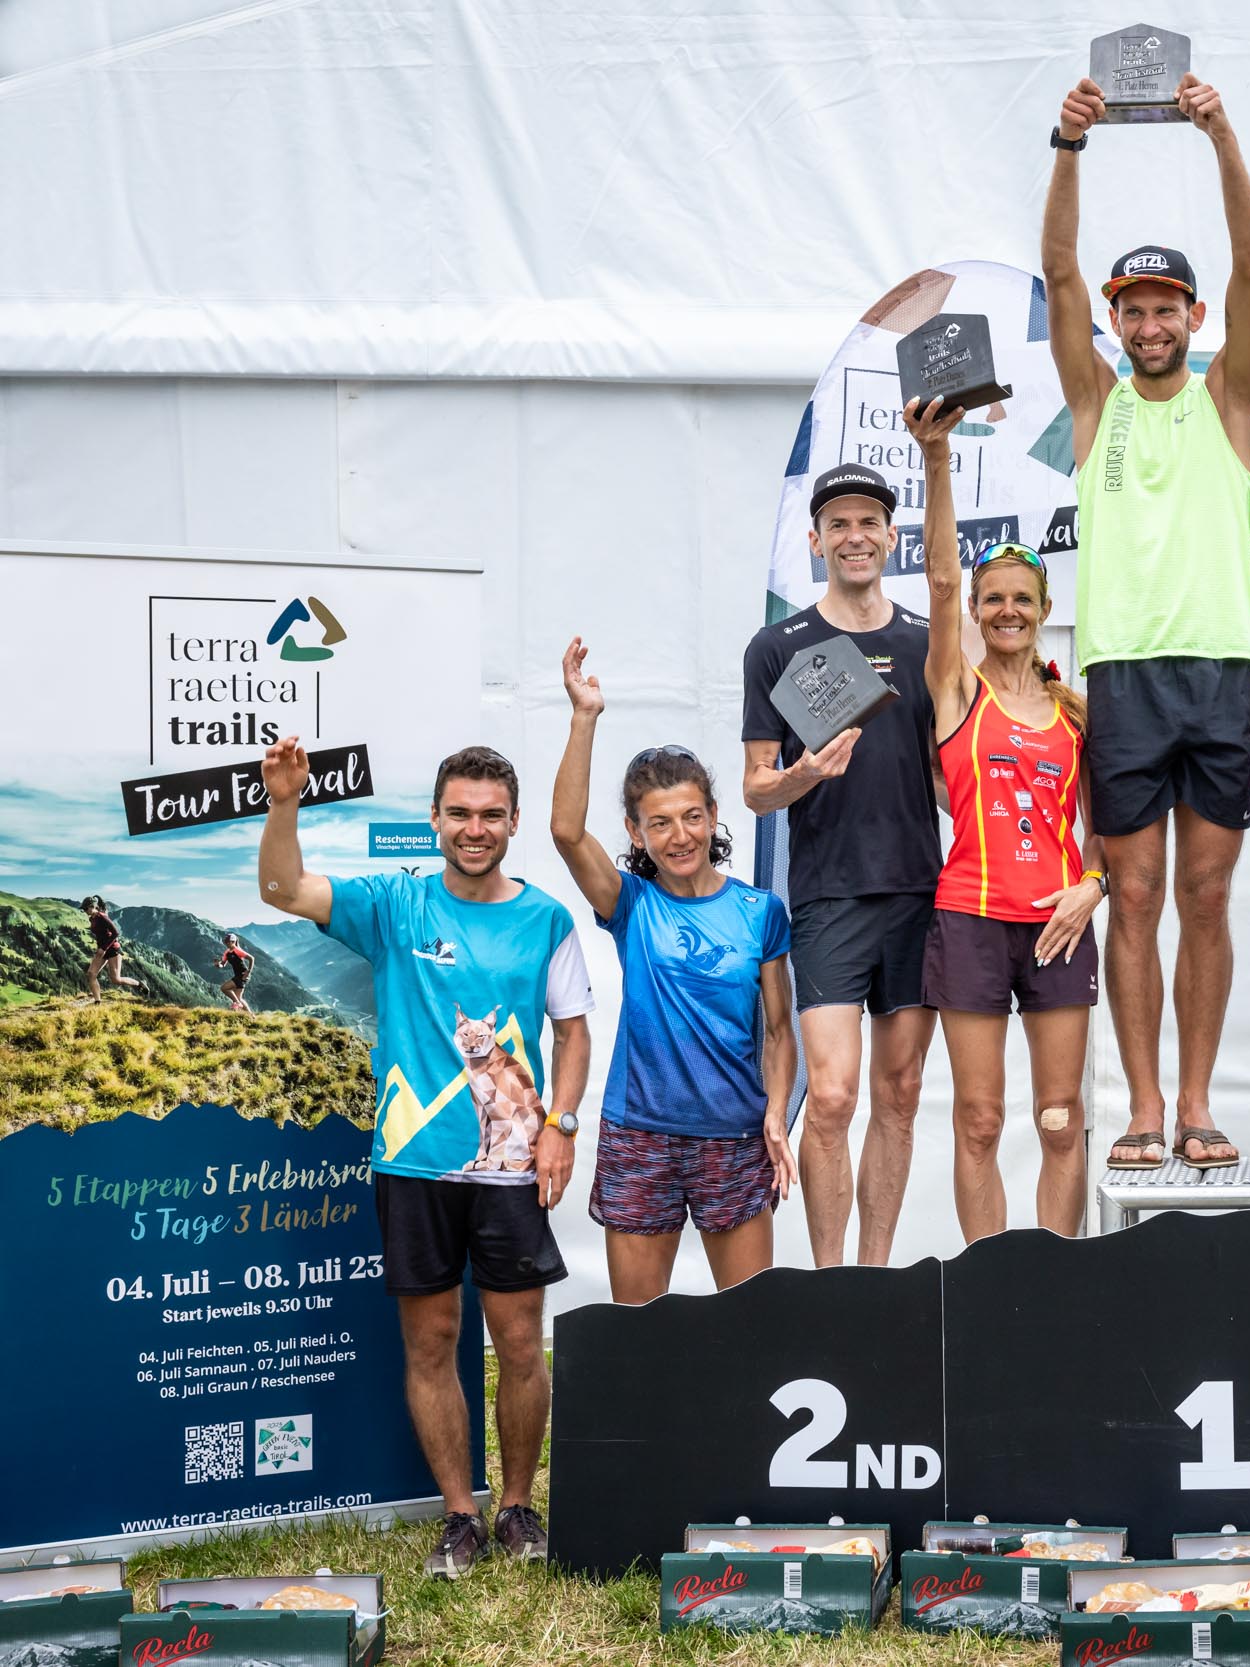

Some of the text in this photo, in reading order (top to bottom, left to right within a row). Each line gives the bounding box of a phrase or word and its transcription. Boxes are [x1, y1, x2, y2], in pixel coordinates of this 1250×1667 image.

[1125, 254, 1170, 276] PETZL
[858, 401, 907, 432] ter
[1110, 398, 1135, 443] NIKE
[856, 443, 963, 473] raeta
[1105, 445, 1126, 491] RUN
[826, 474, 875, 487] SALOMON
[901, 522, 1015, 569] Feival
[167, 632, 260, 663] terra
[167, 672, 300, 704] raetica
[168, 713, 280, 746] trails
[231, 752, 365, 814] Feval
[134, 784, 220, 825] Tour
[375, 835, 432, 845] Reschenpass
[47, 1156, 372, 1210] 5 Etappen 5 Erlebnisrä
[130, 1193, 358, 1246] 5 Tage 3 Länder
[106, 1275, 154, 1303] 04.
[161, 1269, 210, 1302] Juli
[243, 1263, 290, 1291] 08.
[297, 1257, 342, 1289] Juli
[348, 1253, 384, 1282] 23
[162, 1294, 334, 1325] Start jeweils 9.30 Uhr
[136, 1349, 357, 1384] 06. Juli Samnaun 07. Juli Nauders
[139, 1332, 354, 1365] 04. Juli Feichten 05. Juli Ried i. O.
[159, 1385, 180, 1399] 08.
[182, 1382, 205, 1399] Juli
[208, 1378, 249, 1395] Graun
[260, 1370, 336, 1388] Reschensee
[768, 1378, 942, 1490] 2ND
[120, 1491, 373, 1534] www.terra-raetica-trails.com
[674, 1564, 748, 1603] Recla
[913, 1567, 987, 1604] Recla
[132, 1624, 215, 1665] Recla
[1075, 1625, 1154, 1666] Recla
